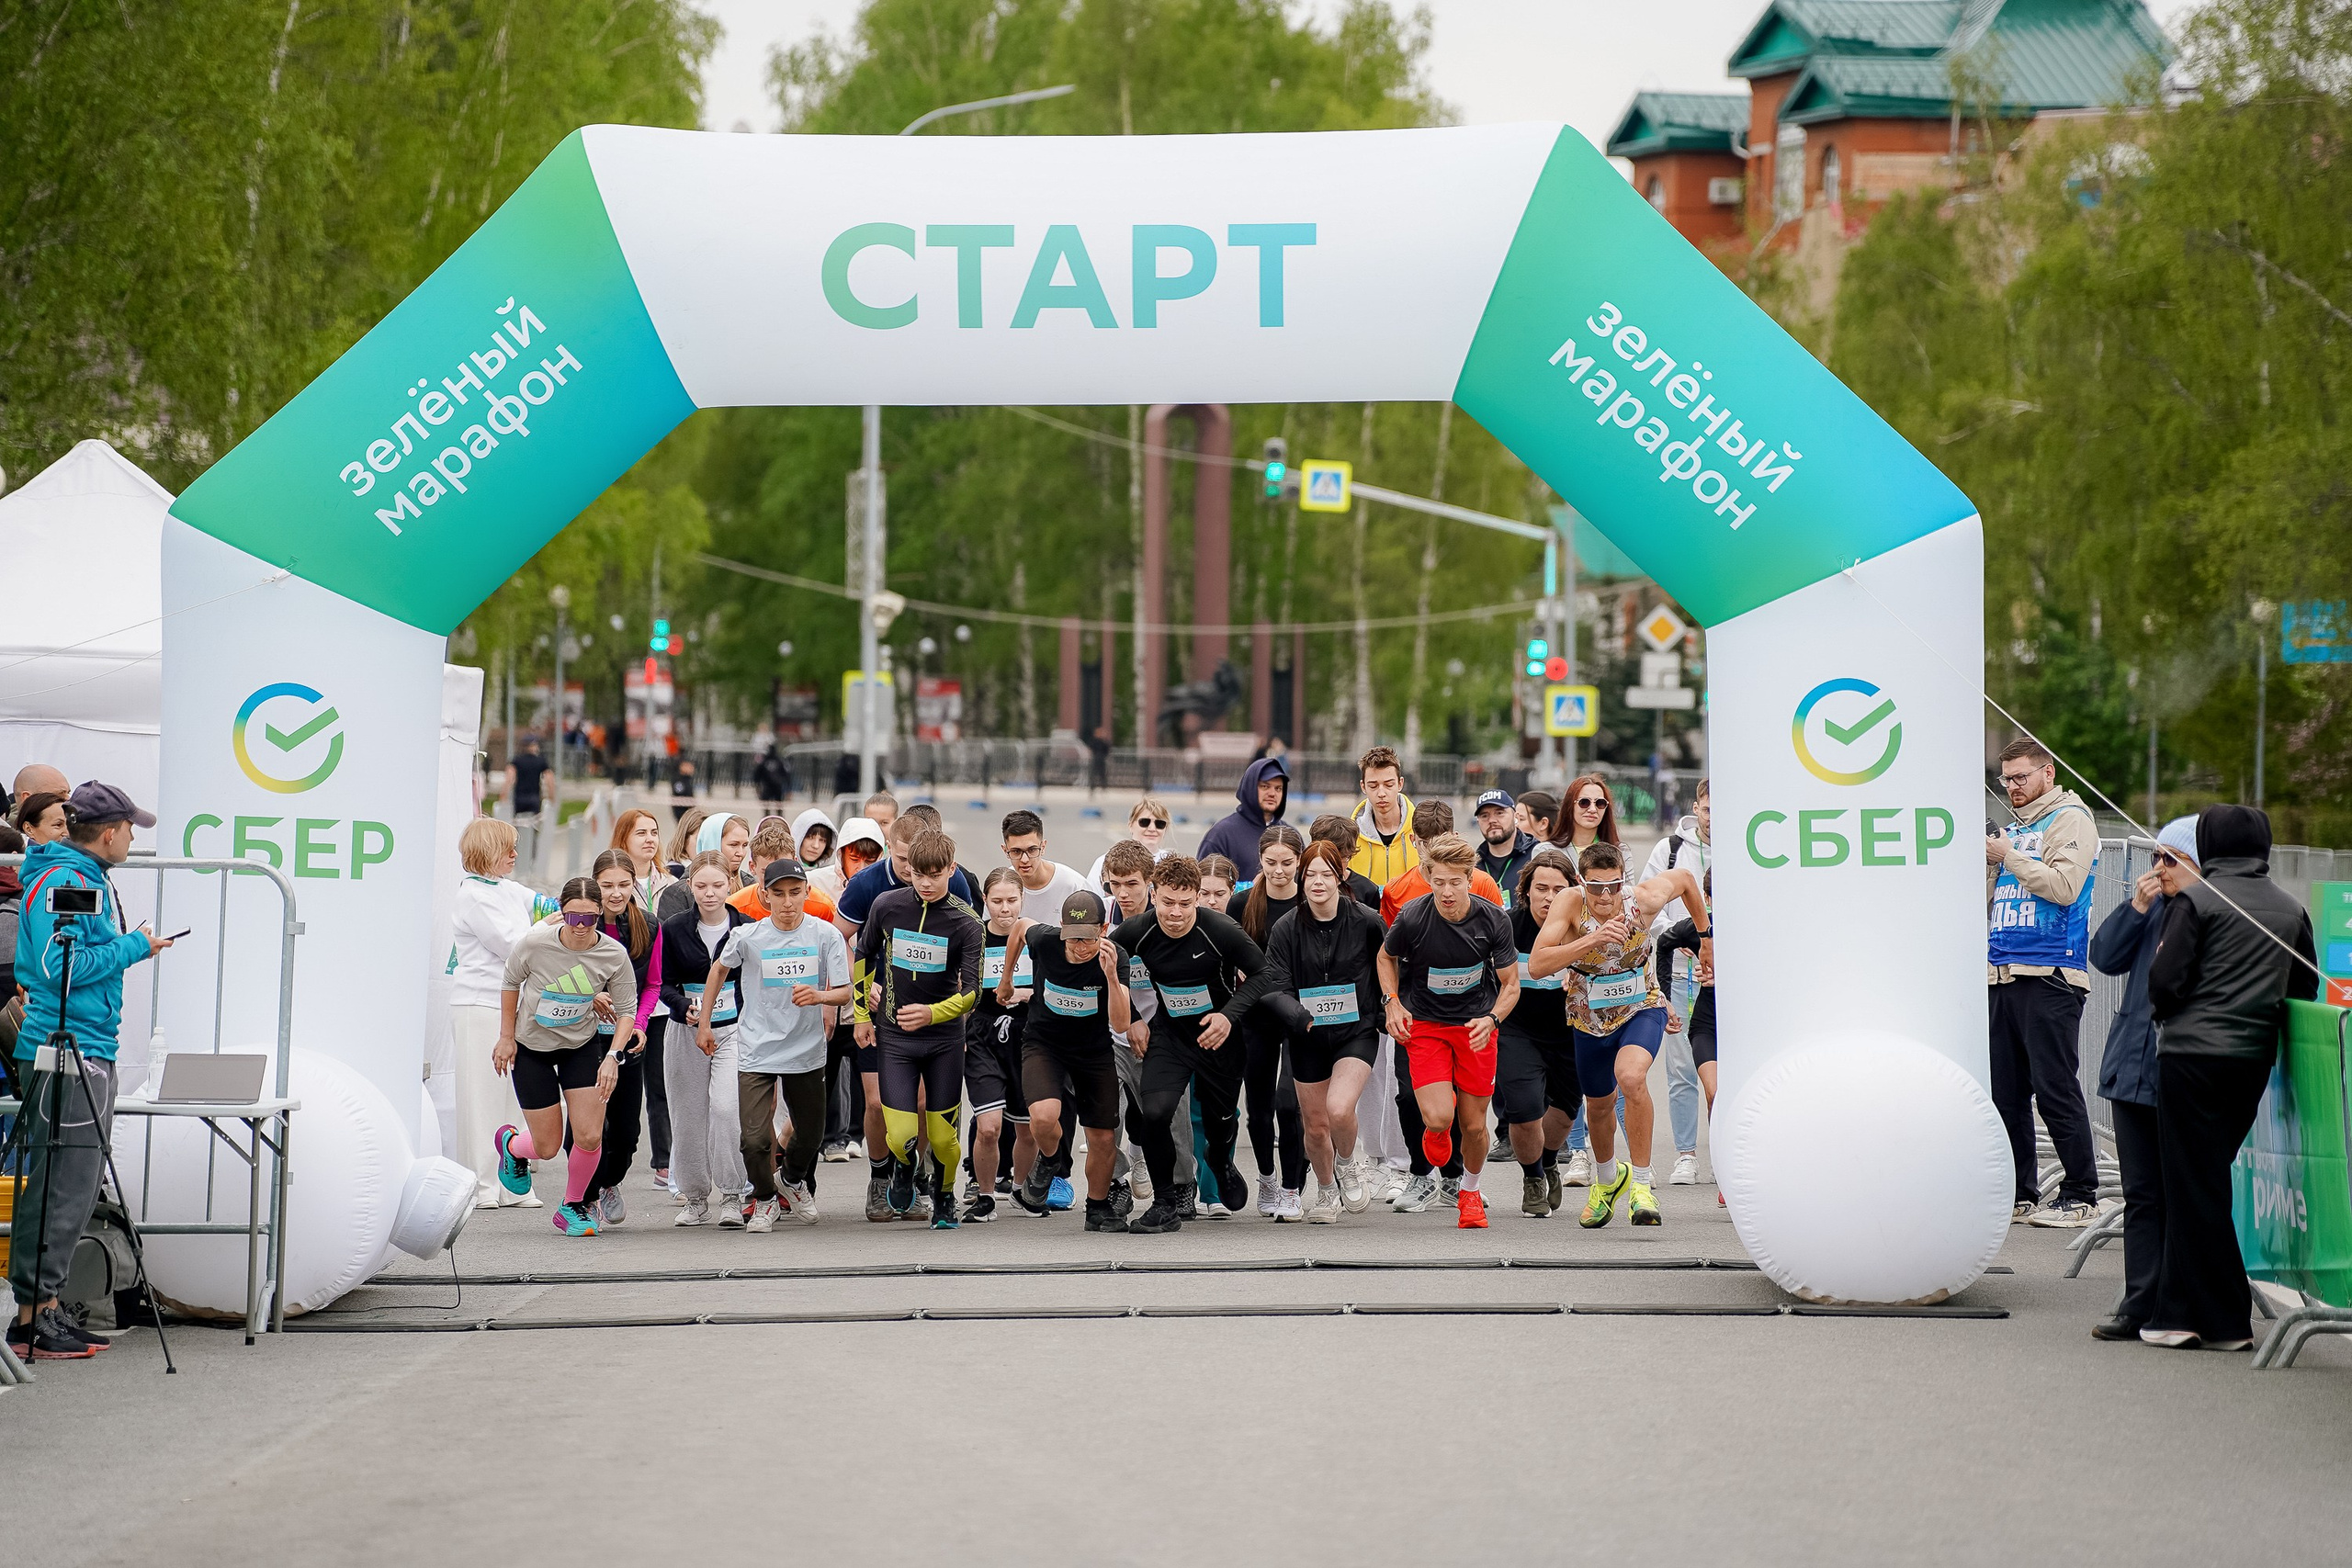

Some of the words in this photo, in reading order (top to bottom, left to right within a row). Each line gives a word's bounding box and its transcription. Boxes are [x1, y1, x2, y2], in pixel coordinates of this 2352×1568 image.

[821, 221, 1317, 330] СТАРТ
[339, 296, 548, 497] зелёный
[1586, 301, 1804, 494] зелёный
[374, 344, 583, 537] марафон
[1548, 338, 1758, 531] марафон
[1746, 807, 1955, 869] СБЕР
[183, 814, 395, 880] СБЕР
[1991, 901, 2036, 932] ДЬЯ
[905, 948, 933, 962] 3301
[776, 964, 806, 976] 3319
[991, 964, 1020, 975] 333
[1130, 969, 1150, 979] 416
[1442, 976, 1472, 987] 3347
[1603, 985, 1633, 997] 3355
[1057, 998, 1084, 1009] 3359
[1169, 998, 1198, 1008] 3332
[1316, 1001, 1344, 1013] 3377
[551, 1008, 579, 1017] 3311
